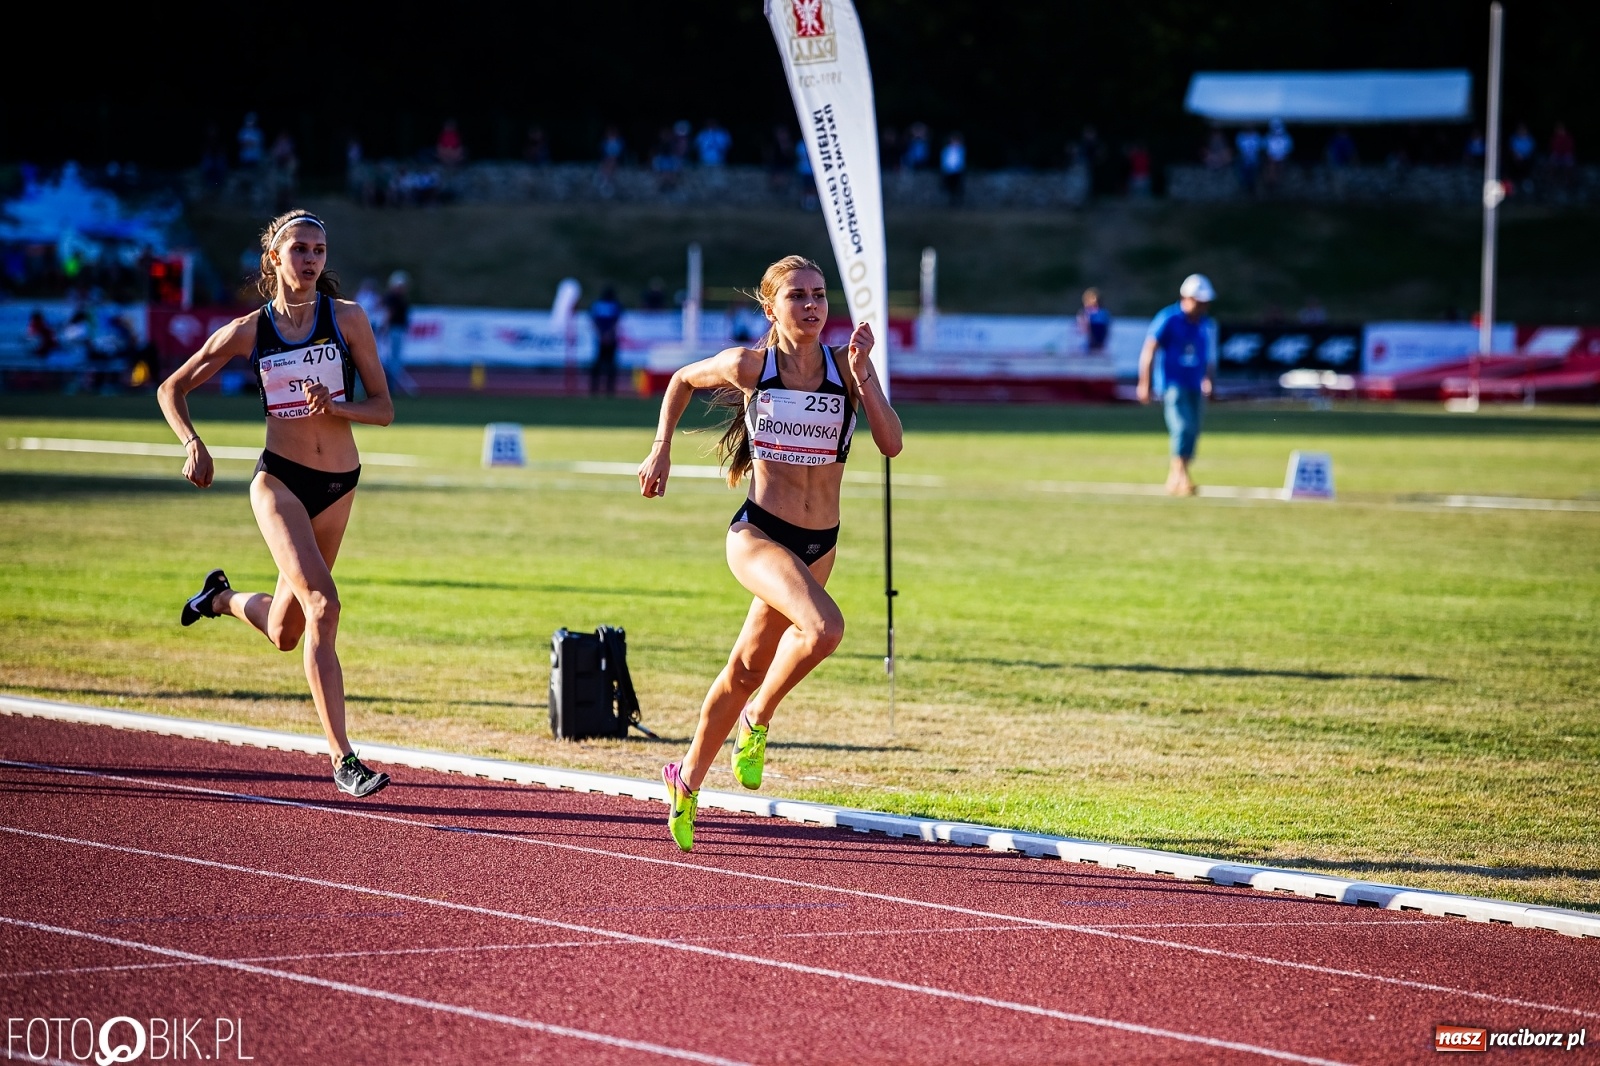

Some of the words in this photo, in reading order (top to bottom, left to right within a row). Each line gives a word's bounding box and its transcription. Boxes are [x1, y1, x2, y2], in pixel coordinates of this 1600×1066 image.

[302, 346, 336, 365] 470
[277, 406, 310, 418] RACIBÓ
[804, 395, 841, 414] 253
[758, 418, 838, 440] BRONOWSKA
[761, 450, 805, 464] RACIBÓRZ
[806, 456, 827, 465] 2019
